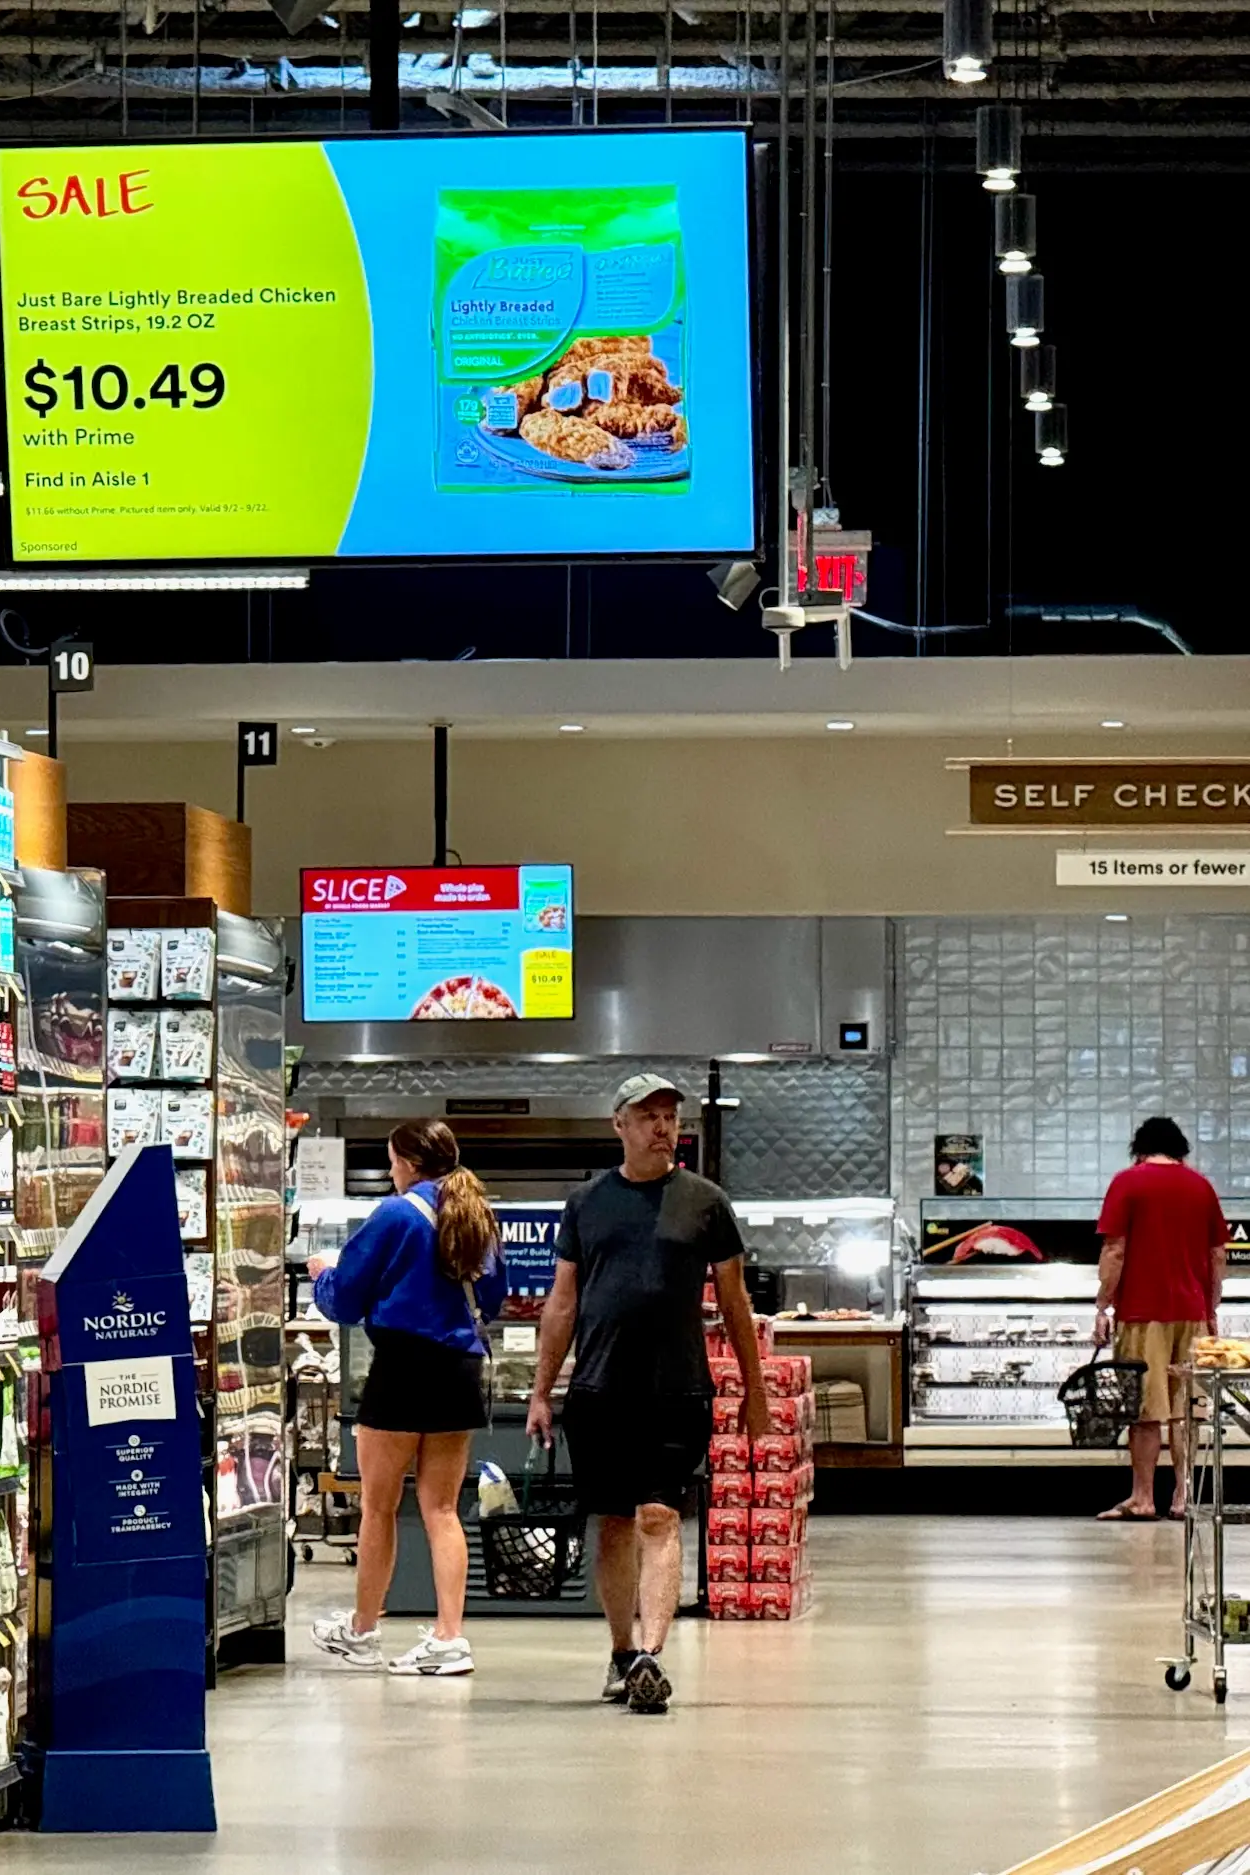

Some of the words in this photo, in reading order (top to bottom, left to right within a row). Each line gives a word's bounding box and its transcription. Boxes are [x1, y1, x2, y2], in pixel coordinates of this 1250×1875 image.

[16, 169, 155, 220] SALE
[17, 292, 56, 308] Just
[62, 292, 103, 308] Bare
[108, 290, 171, 310] Lightly
[177, 288, 254, 305] Breaded
[259, 287, 336, 304] Chicken
[451, 300, 496, 315] Lightly
[500, 300, 555, 312] Breaded
[18, 317, 76, 332] Breast
[81, 315, 141, 334] Strips,
[146, 315, 182, 330] 19.2
[187, 313, 216, 329] OZ
[454, 355, 503, 367] ORIGINAL
[23, 358, 226, 419] $10.49
[22, 429, 68, 446] with
[75, 428, 135, 446] Prime
[25, 472, 64, 488] Find
[70, 472, 86, 487] in
[91, 470, 137, 487] Aisle
[141, 471, 150, 486] 1
[56, 506, 90, 516] without
[119, 505, 155, 515] Pictured
[199, 504, 221, 513] Valid
[223, 503, 239, 514] 9/2
[20, 541, 78, 555] Sponsored
[54, 651, 90, 681] 10
[243, 730, 271, 756] 11
[994, 783, 1095, 808] SELF
[1112, 783, 1250, 808] CHECK
[1088, 861, 1108, 875] 15
[1113, 860, 1163, 876] Items
[1168, 863, 1188, 876] or
[1193, 860, 1246, 876] fewer
[312, 878, 384, 902] SLICE
[531, 975, 563, 985] $10.49
[501, 1222, 549, 1243] MILY
[529, 1247, 552, 1256] Build
[512, 1258, 550, 1268] Prepared
[83, 1311, 167, 1332] NORDIC
[95, 1327, 159, 1341] NATURALS
[119, 1373, 137, 1381] THE
[100, 1380, 160, 1397] NORDIC
[99, 1393, 162, 1410] PROMISE
[115, 1446, 155, 1457] SUPERIOR
[118, 1453, 153, 1462] QUALITY
[115, 1483, 139, 1492] MADE
[139, 1481, 161, 1491] WITH
[117, 1488, 160, 1498] INTEGRITY
[110, 1521, 172, 1534] TRANSPARENCY
[121, 1516, 159, 1526] PRODUCT
